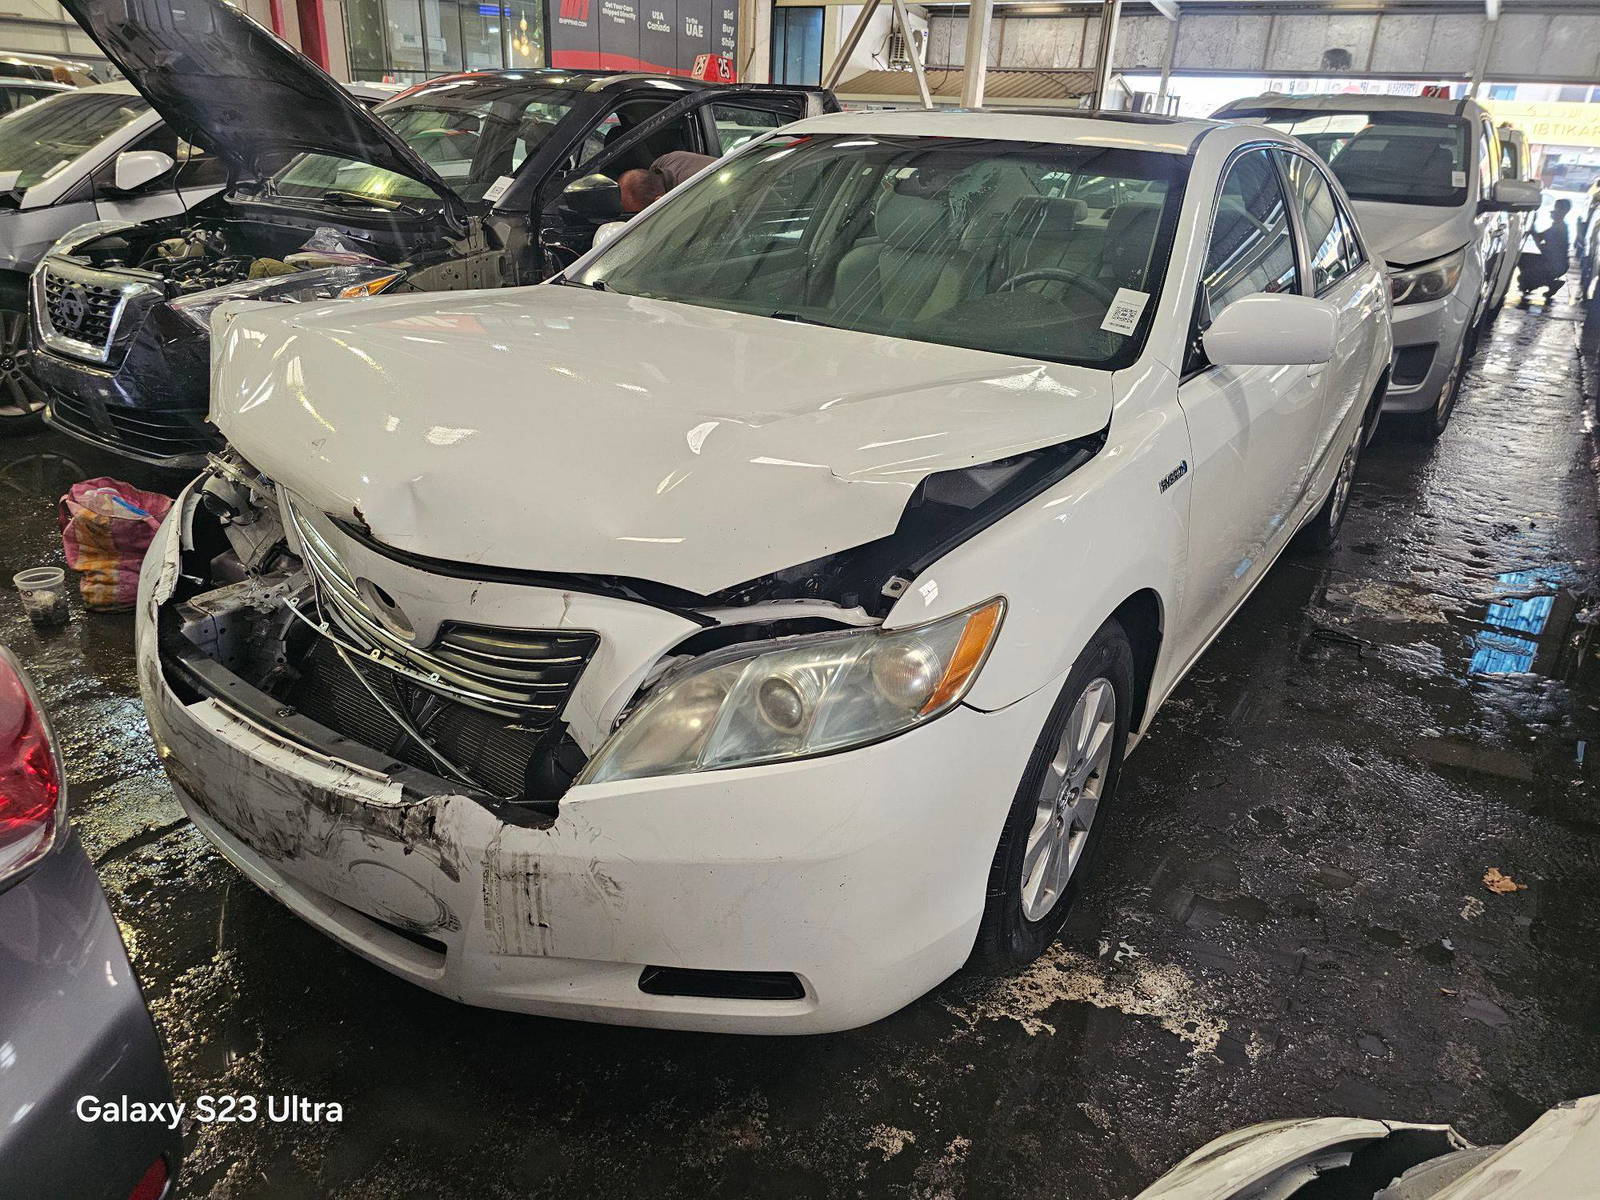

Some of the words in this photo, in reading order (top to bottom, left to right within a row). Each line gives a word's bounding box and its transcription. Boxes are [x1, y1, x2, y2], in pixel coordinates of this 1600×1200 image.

[652, 10, 664, 20] USA
[723, 9, 734, 20] Bid
[647, 21, 670, 32] Canada
[686, 24, 703, 37] UAE
[722, 24, 734, 36] Buy
[721, 37, 735, 50] Ship
[718, 58, 730, 79] 25
